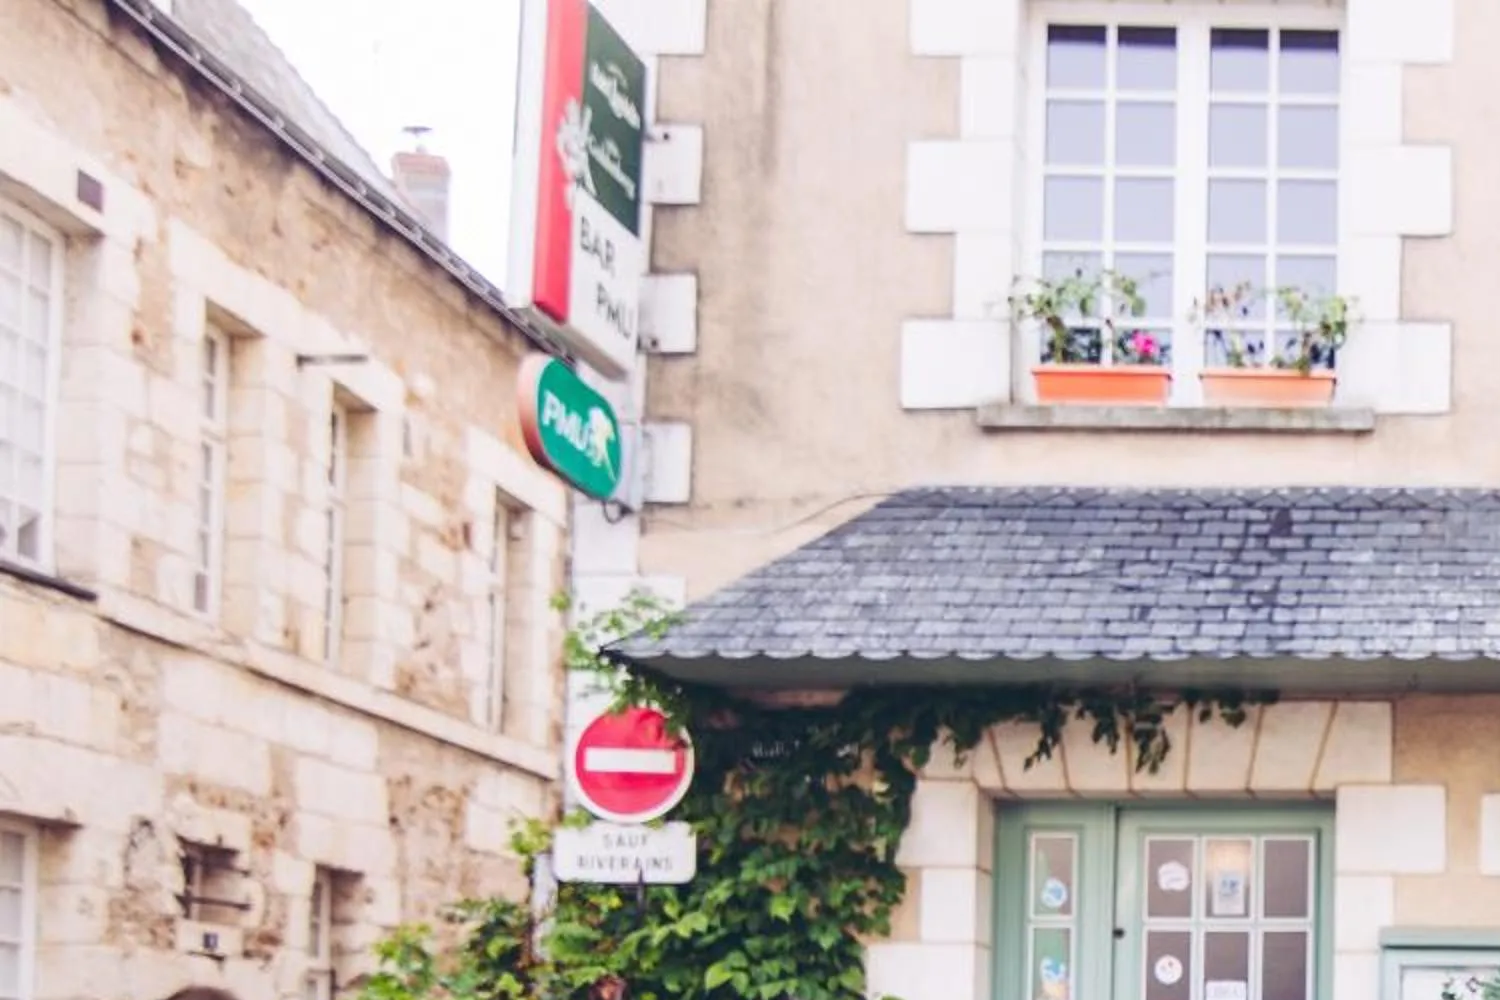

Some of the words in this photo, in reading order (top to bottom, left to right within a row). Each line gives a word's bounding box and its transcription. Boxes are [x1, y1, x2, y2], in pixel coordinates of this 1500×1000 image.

[580, 214, 616, 279] BAR
[596, 280, 633, 341] PMU
[542, 388, 594, 454] PMU
[577, 854, 674, 871] RIVERAINS
[602, 832, 649, 849] SAUF
